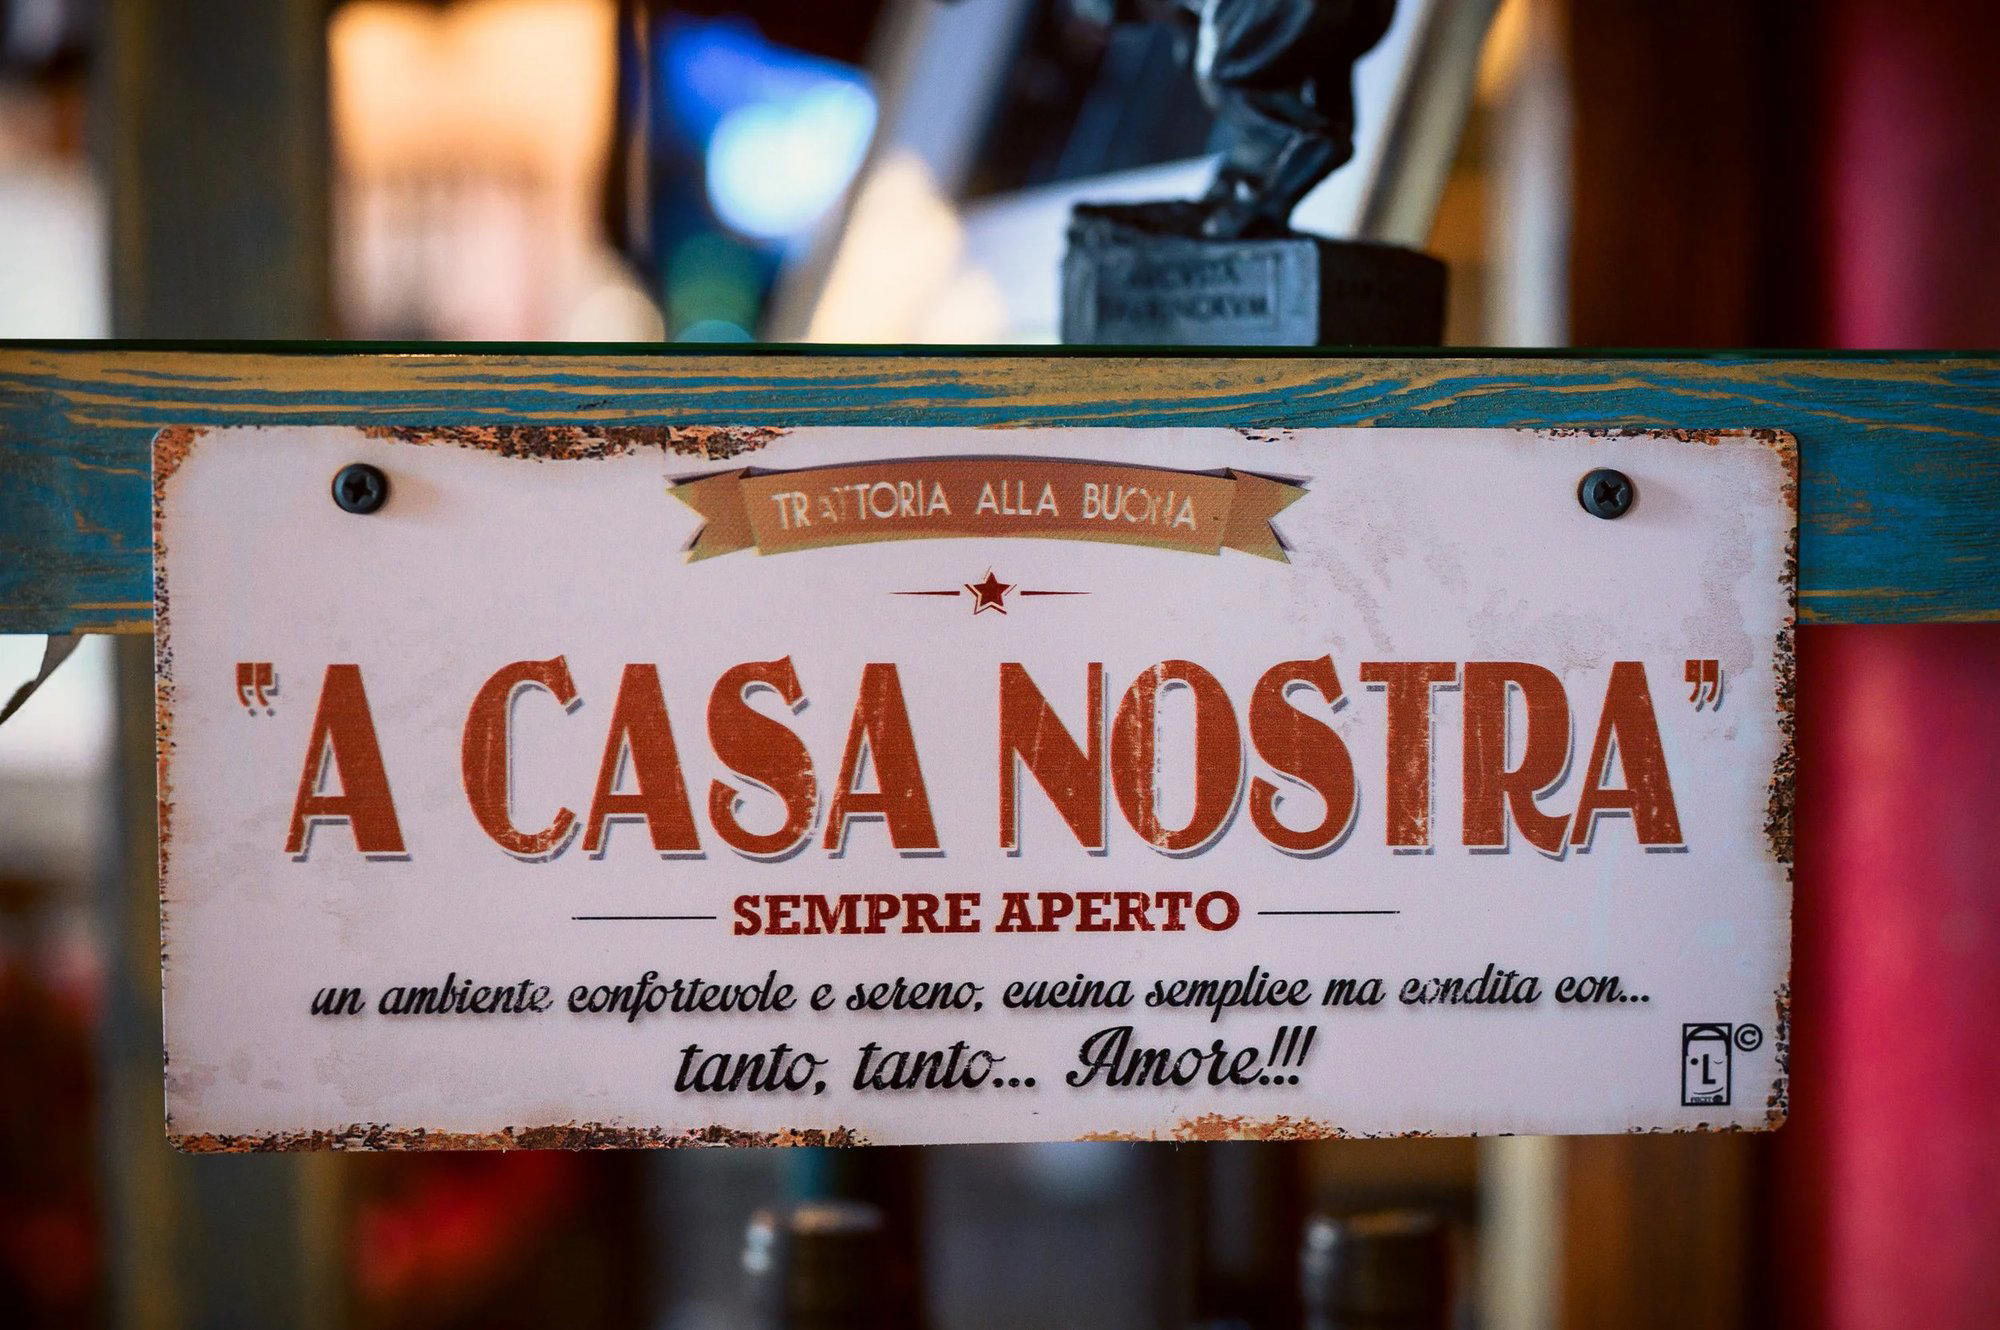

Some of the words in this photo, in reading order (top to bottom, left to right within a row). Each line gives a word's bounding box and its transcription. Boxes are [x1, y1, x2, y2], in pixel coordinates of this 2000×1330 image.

[975, 480, 1059, 518] ALLA
[460, 655, 945, 860] CASA
[731, 891, 982, 937] SEMPRE
[994, 890, 1241, 934] APERTO
[310, 986, 366, 1016] un
[377, 972, 554, 1016] ambiente
[566, 969, 798, 1024] confortevole
[810, 983, 836, 1012] e
[846, 976, 985, 1013] sereno,
[1002, 973, 1135, 1010] cucina
[1144, 964, 1312, 1023] semplice
[1322, 978, 1391, 1008] ma
[1398, 962, 1543, 1006] condita
[1554, 976, 1651, 1004] con...
[674, 1042, 829, 1095] tanto,
[852, 1040, 1036, 1090] tanto...
[1065, 1024, 1319, 1090] Amore!!!
